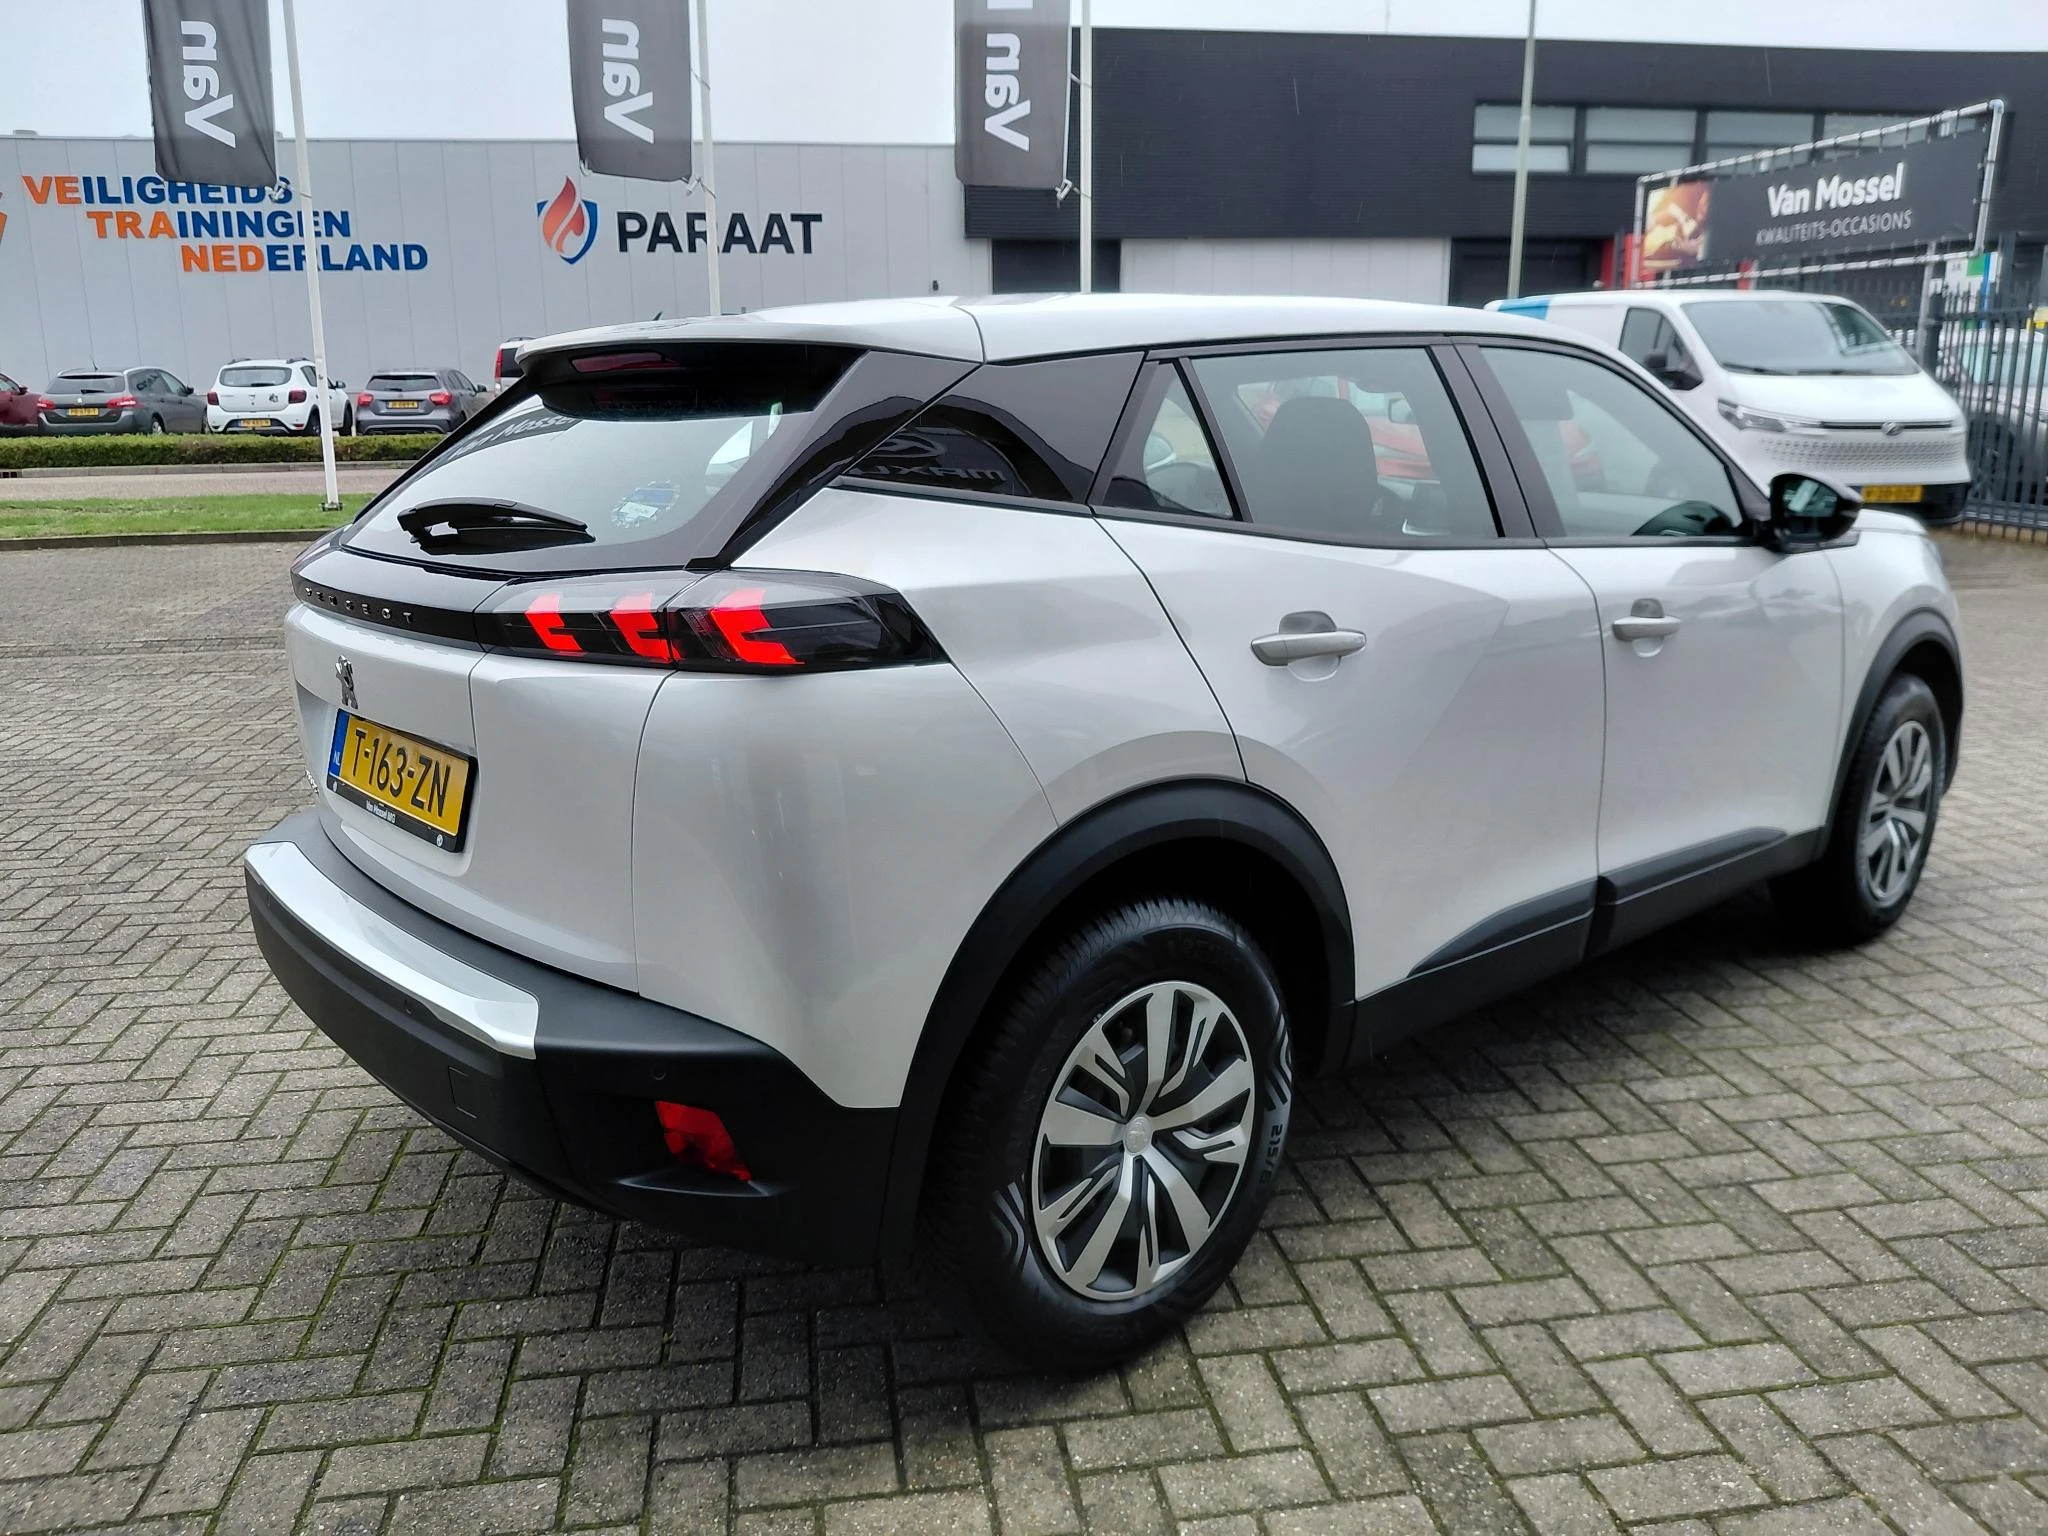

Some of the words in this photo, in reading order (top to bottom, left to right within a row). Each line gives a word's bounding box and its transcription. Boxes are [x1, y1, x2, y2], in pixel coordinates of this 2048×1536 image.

[181, 20, 236, 148] Van
[602, 18, 654, 144] Van
[985, 33, 1031, 151] Van
[22, 175, 293, 204] VEILIGHEIDS
[1767, 184, 1811, 218] Van
[1814, 161, 1905, 212] Mossel
[86, 210, 351, 239] TRAININGEN
[616, 211, 823, 254] PARAAT
[1755, 208, 1913, 246] KWALITEITS-OCCASIONS
[181, 244, 429, 272] NEDERLAND
[305, 587, 412, 623] PEUGEOT
[353, 727, 451, 818] T-163-ZN
